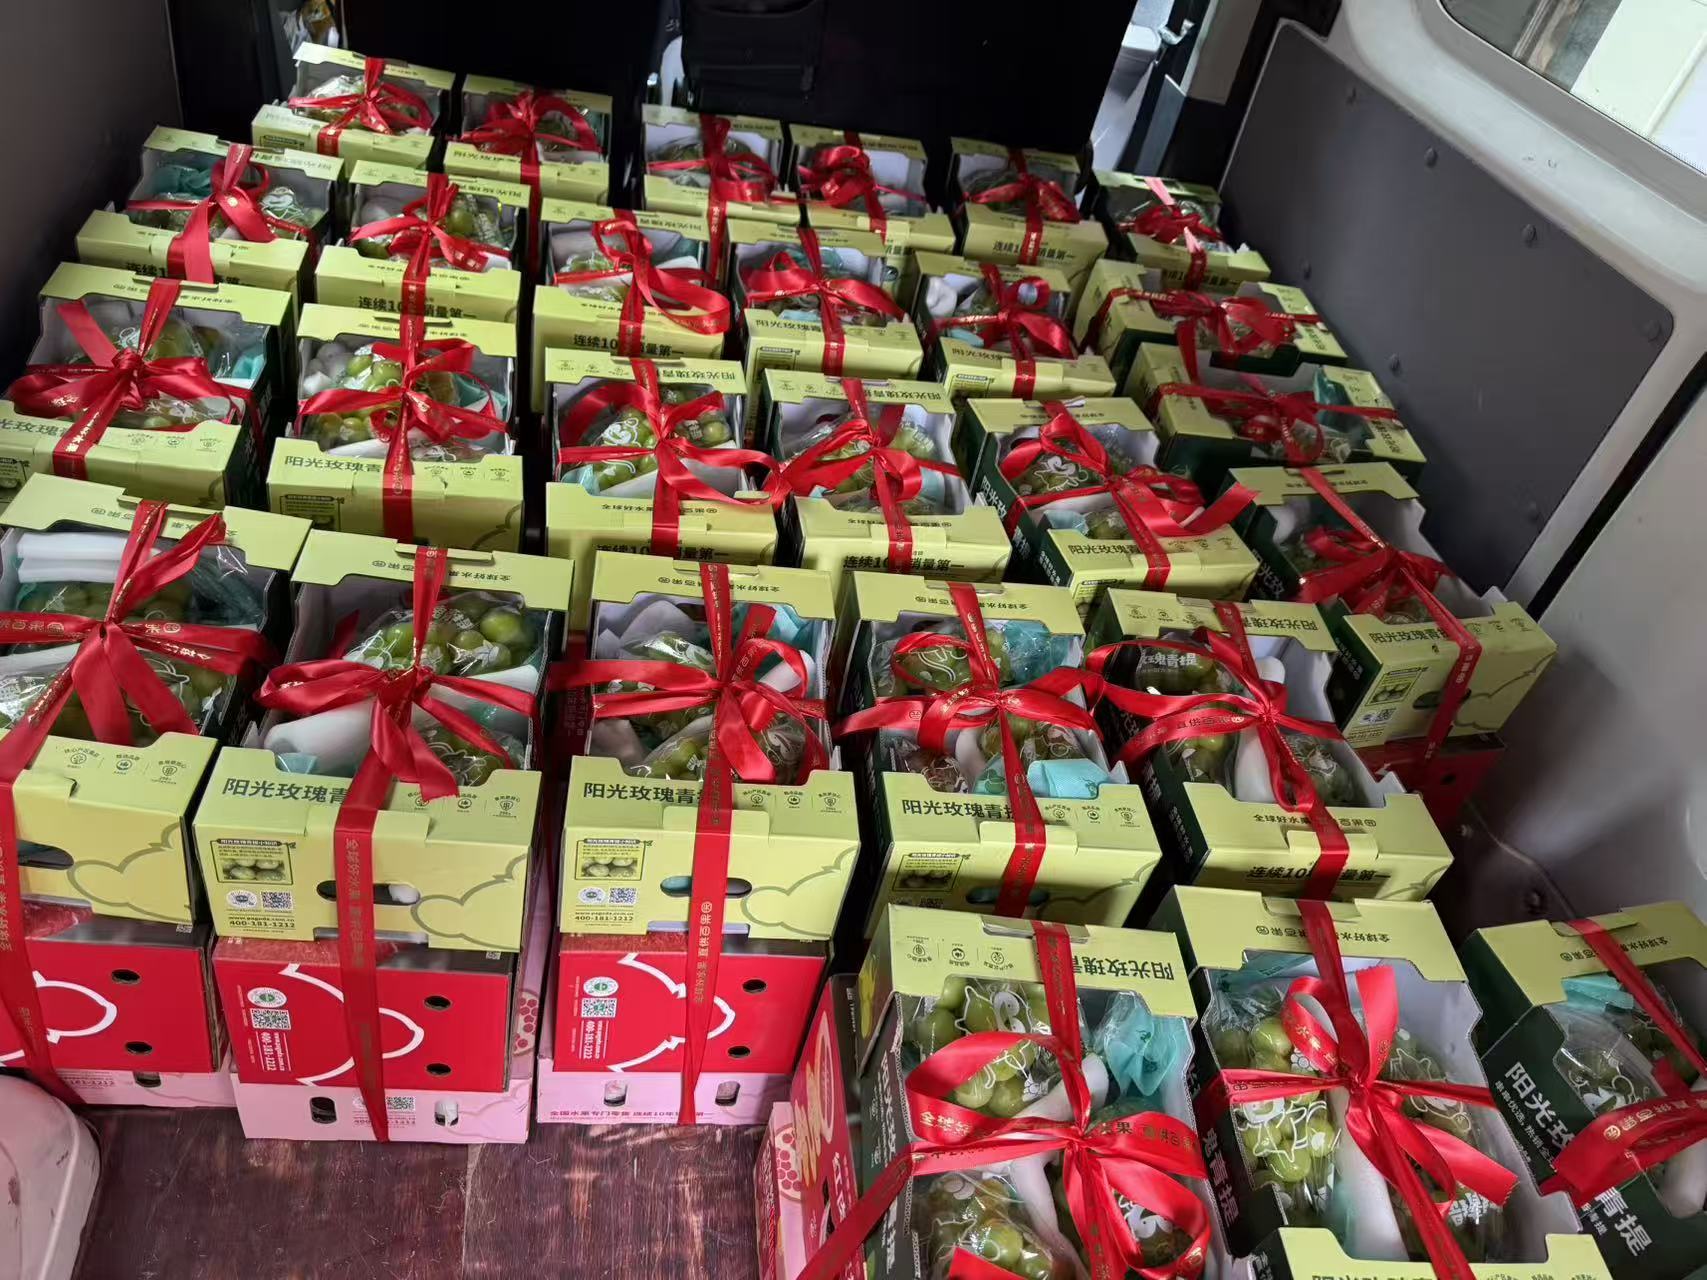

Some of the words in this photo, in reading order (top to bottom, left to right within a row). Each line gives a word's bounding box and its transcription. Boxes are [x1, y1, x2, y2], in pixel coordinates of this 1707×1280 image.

[358, 296, 477, 319] 连续10销量第一
[284, 455, 382, 473] 阳光玫瑰青
[222, 777, 350, 805] 阳光玫瑰青
[583, 782, 704, 804] 阳光玫瑰青
[1248, 865, 1392, 883] 连续10量第一
[1072, 955, 1176, 982] 阳光玫瑰
[1504, 1061, 1653, 1257] 阳光玫青提
